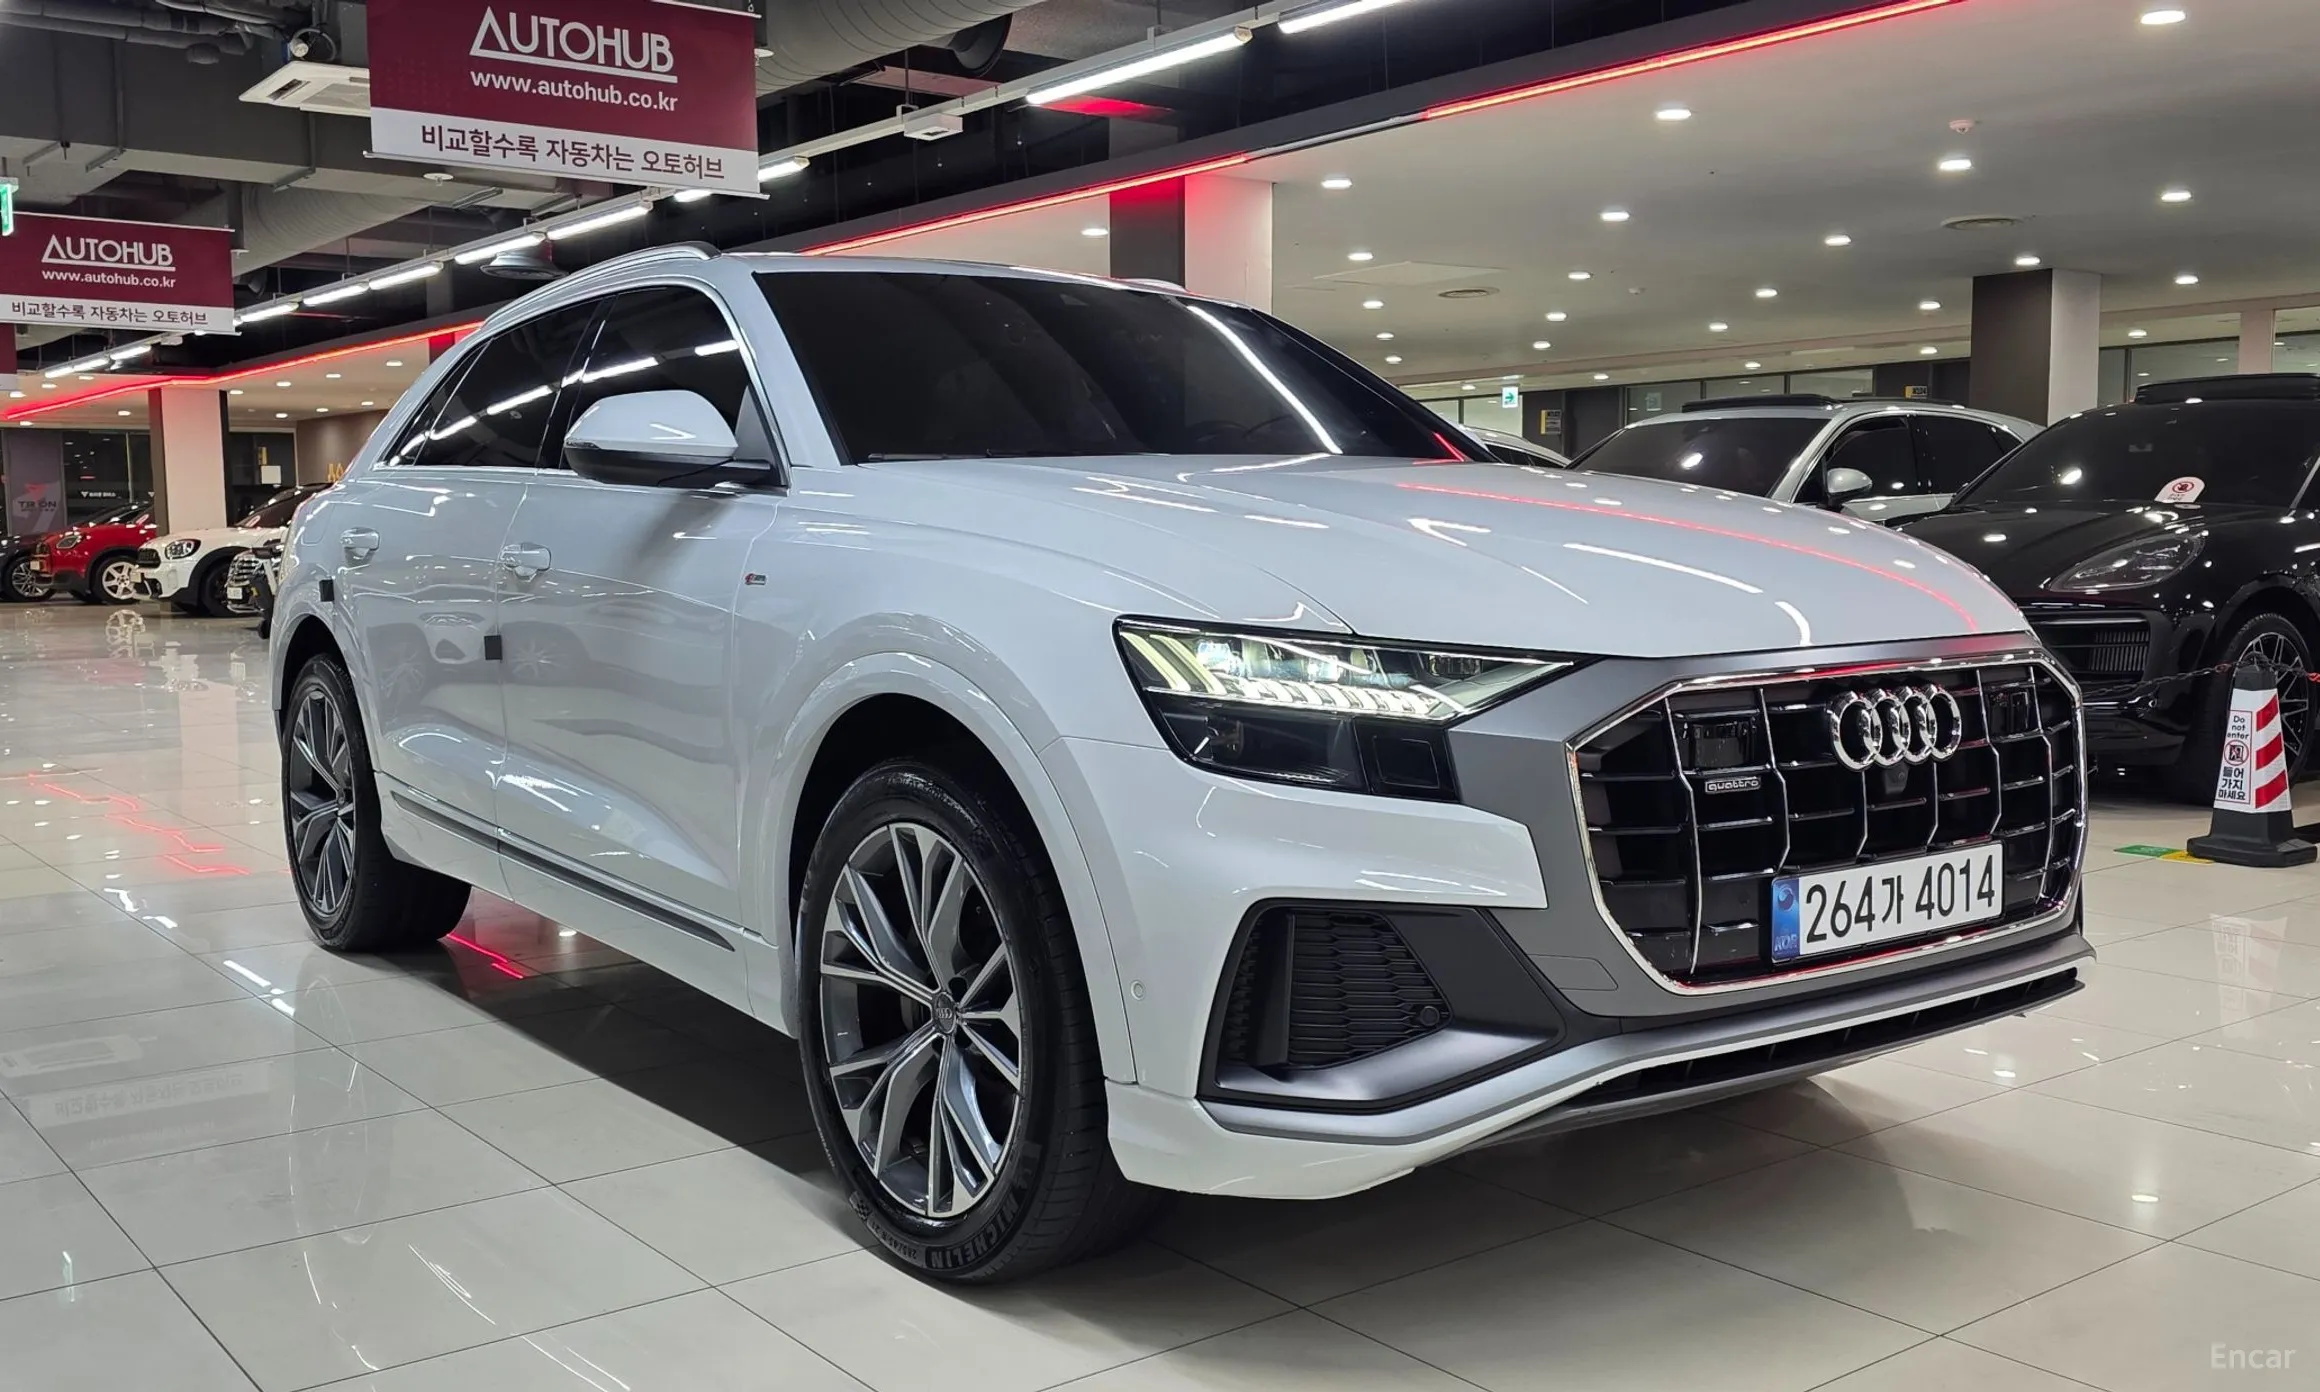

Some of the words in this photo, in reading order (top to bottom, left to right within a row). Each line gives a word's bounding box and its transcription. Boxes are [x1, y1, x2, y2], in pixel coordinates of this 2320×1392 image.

[469, 5, 678, 82] AUTOHUB
[470, 71, 678, 112] www.autohub.co.kr
[421, 124, 539, 163] 비교할수록
[546, 139, 635, 173] 자동차는
[642, 150, 725, 180] 오토허브
[41, 234, 176, 271] AUTOHUB
[42, 269, 176, 288] www.autohub.co.kr
[11, 301, 86, 320] 비교할수록
[91, 306, 148, 323] 자동차는
[152, 310, 208, 326] 오토허브
[2231, 724, 2246, 732] not
[2233, 715, 2245, 723] Do
[2227, 732, 2249, 740] enter
[1708, 779, 1759, 792] quattro
[2218, 789, 2246, 801] 마세요
[2221, 778, 2243, 790] 가지
[1806, 874, 1903, 943] 264가
[1915, 854, 1996, 921] 4014
[931, 1192, 1019, 1269] MICHELIN
